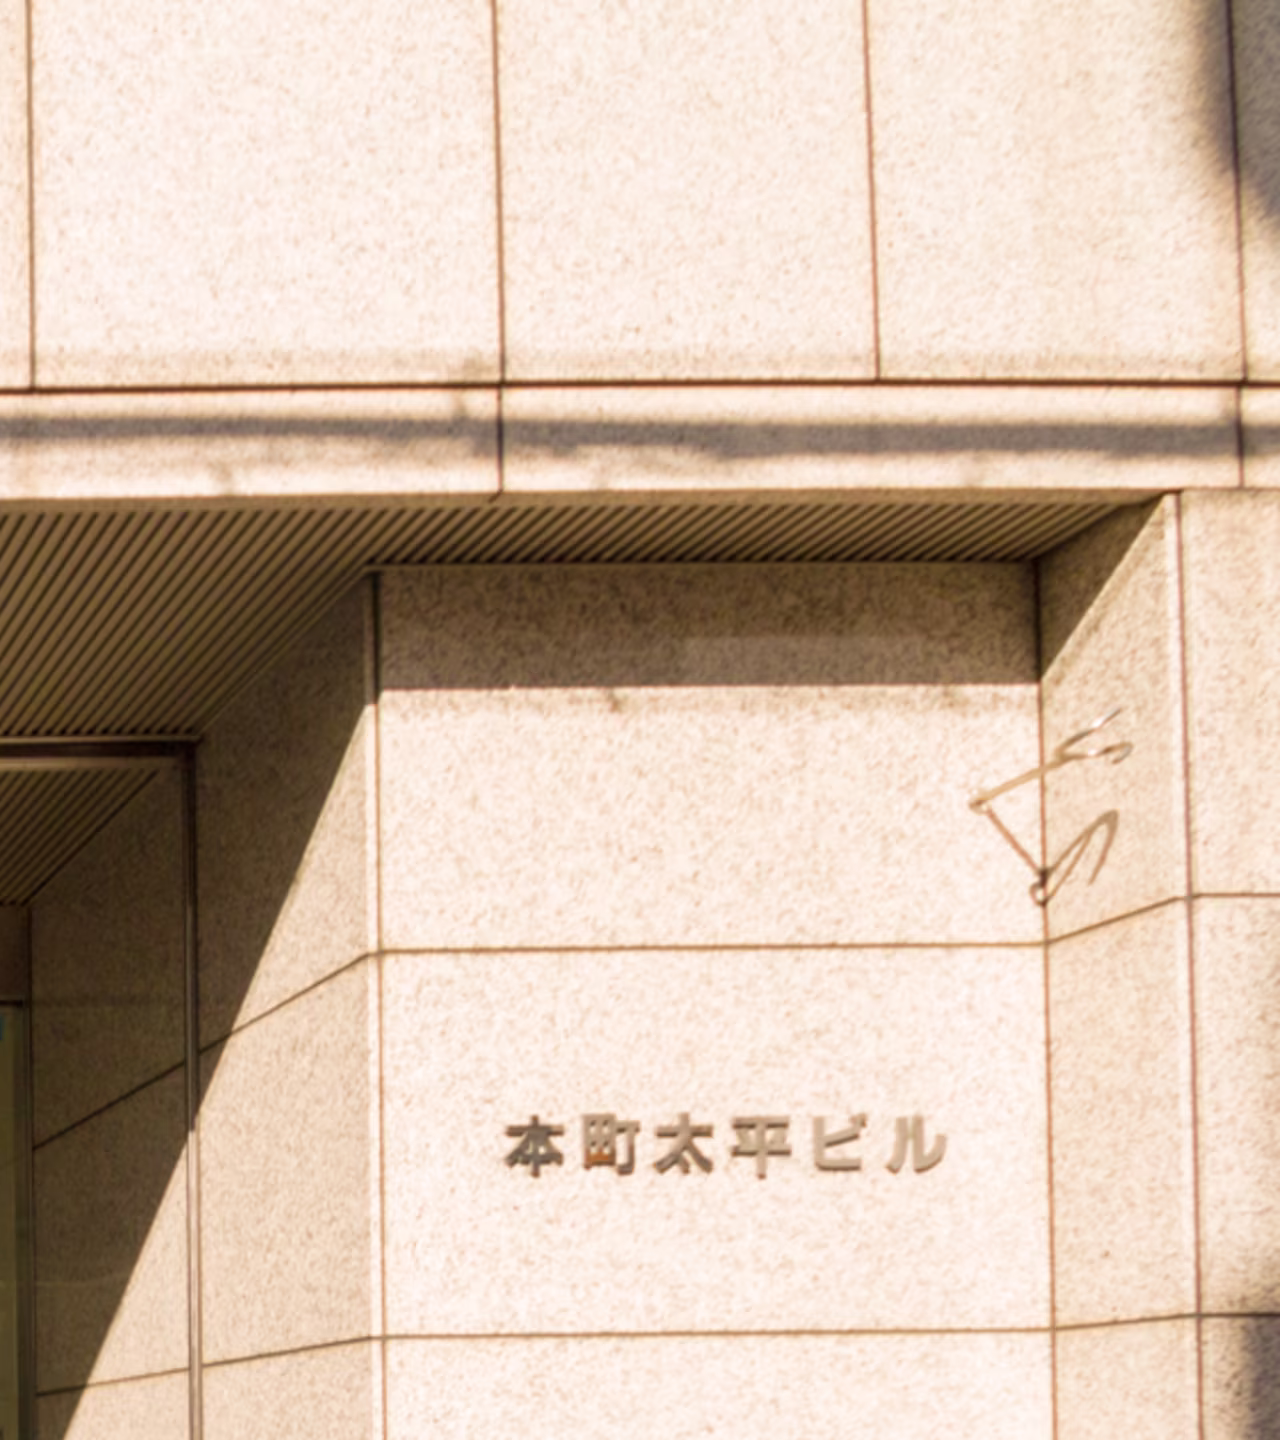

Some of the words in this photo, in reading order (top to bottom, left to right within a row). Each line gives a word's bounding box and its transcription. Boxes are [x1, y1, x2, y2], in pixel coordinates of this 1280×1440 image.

[505, 1112, 947, 1180] 本町太平ビル
